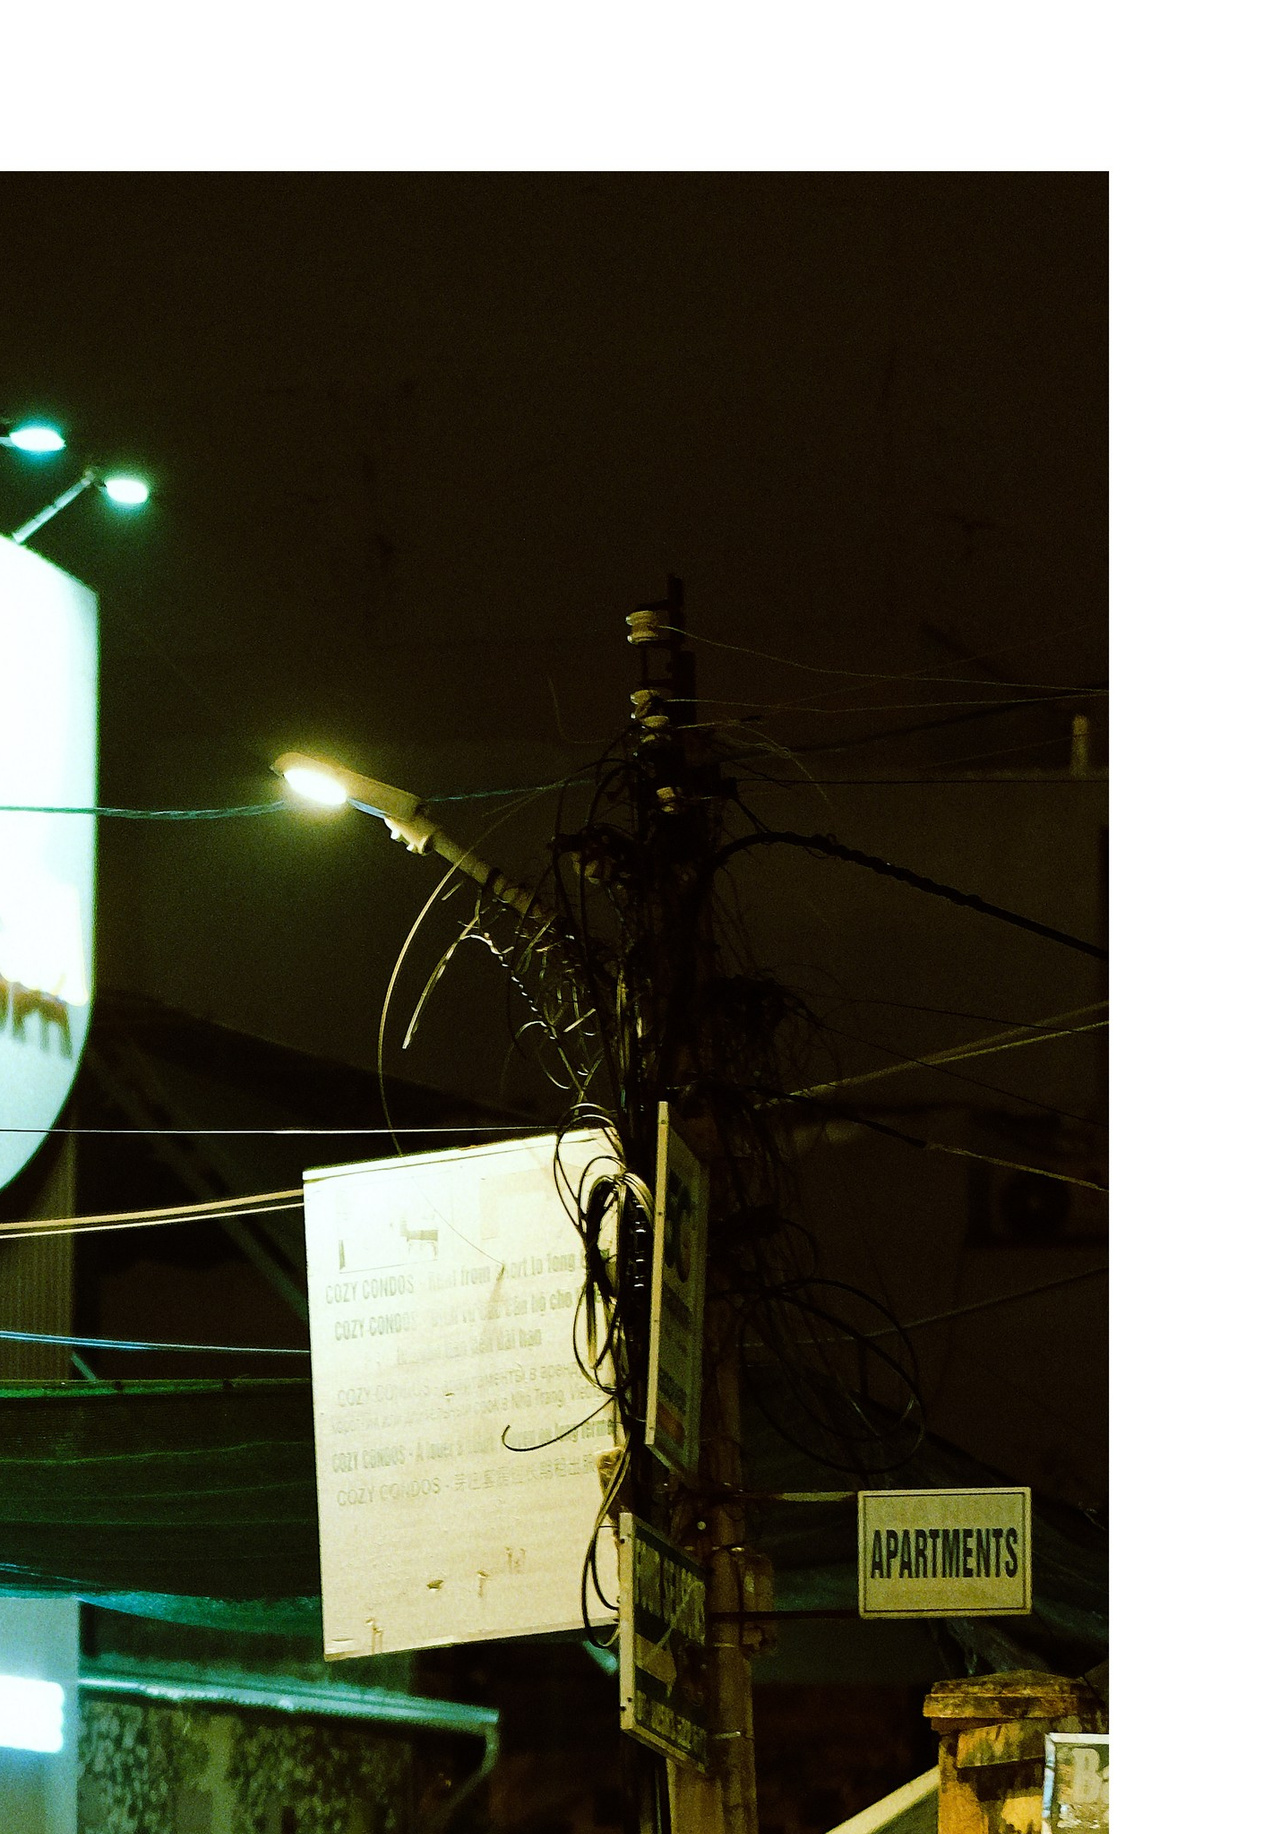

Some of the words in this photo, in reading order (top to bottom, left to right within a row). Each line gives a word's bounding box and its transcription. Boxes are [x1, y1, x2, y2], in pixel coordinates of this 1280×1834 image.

[325, 1281, 357, 1305] COZY
[362, 1274, 415, 1300] CONDOS
[334, 1318, 365, 1341] COZY
[336, 1486, 375, 1507] COZY
[870, 1526, 1019, 1579] APARTMENTS
